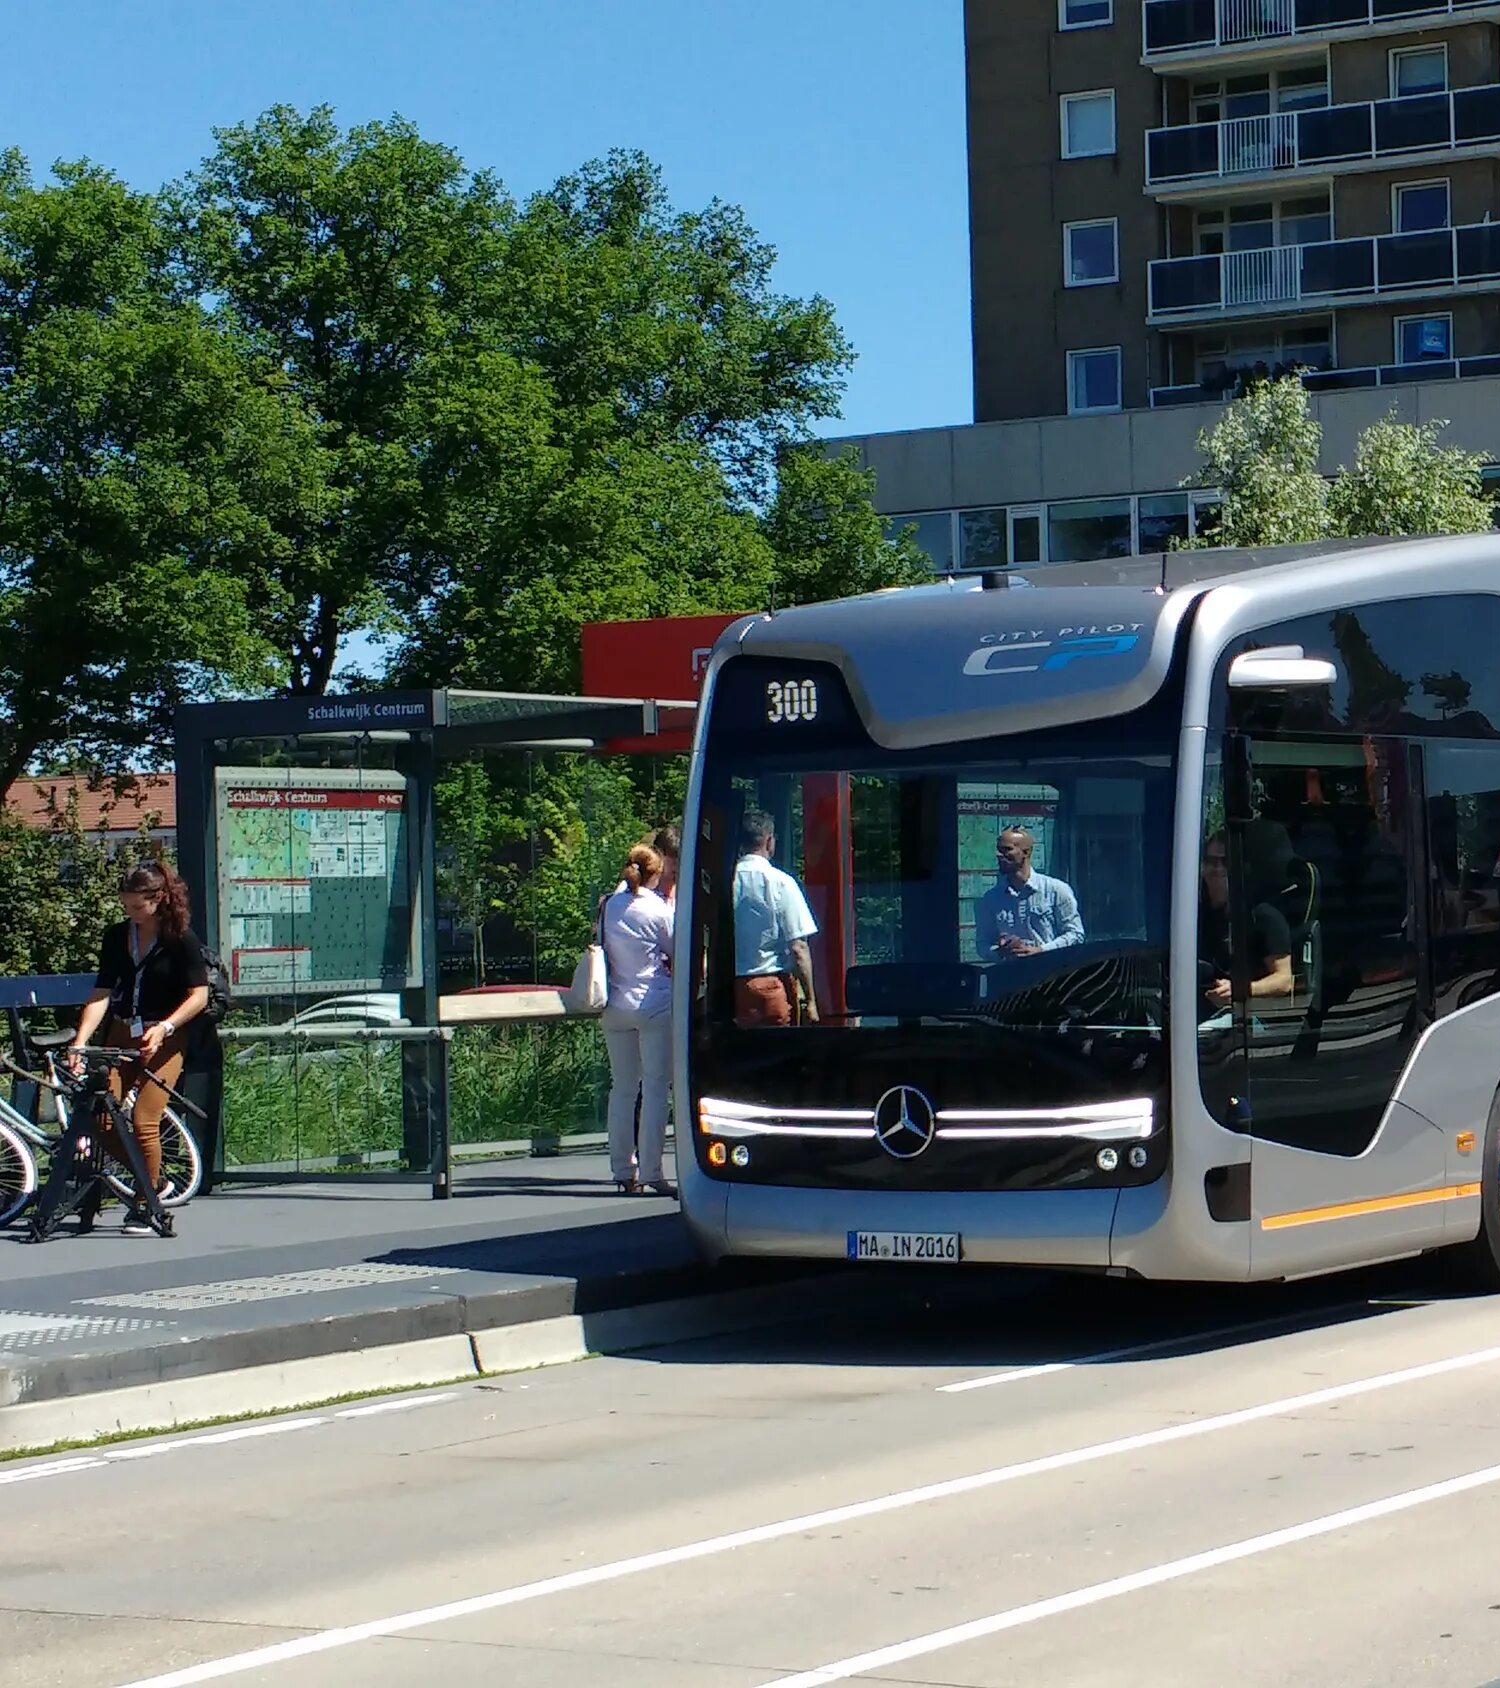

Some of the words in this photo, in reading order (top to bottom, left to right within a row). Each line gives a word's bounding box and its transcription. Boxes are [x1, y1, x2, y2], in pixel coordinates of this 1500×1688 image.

[979, 630, 1044, 644] CITY
[1058, 623, 1144, 637] PILOT
[963, 634, 1139, 676] CP
[307, 705, 371, 720] Schalkwijk
[374, 702, 425, 717] Centrum
[767, 679, 817, 723] 300
[859, 1235, 879, 1256] MA
[892, 1235, 912, 1257] IN
[915, 1236, 956, 1258] 2016
